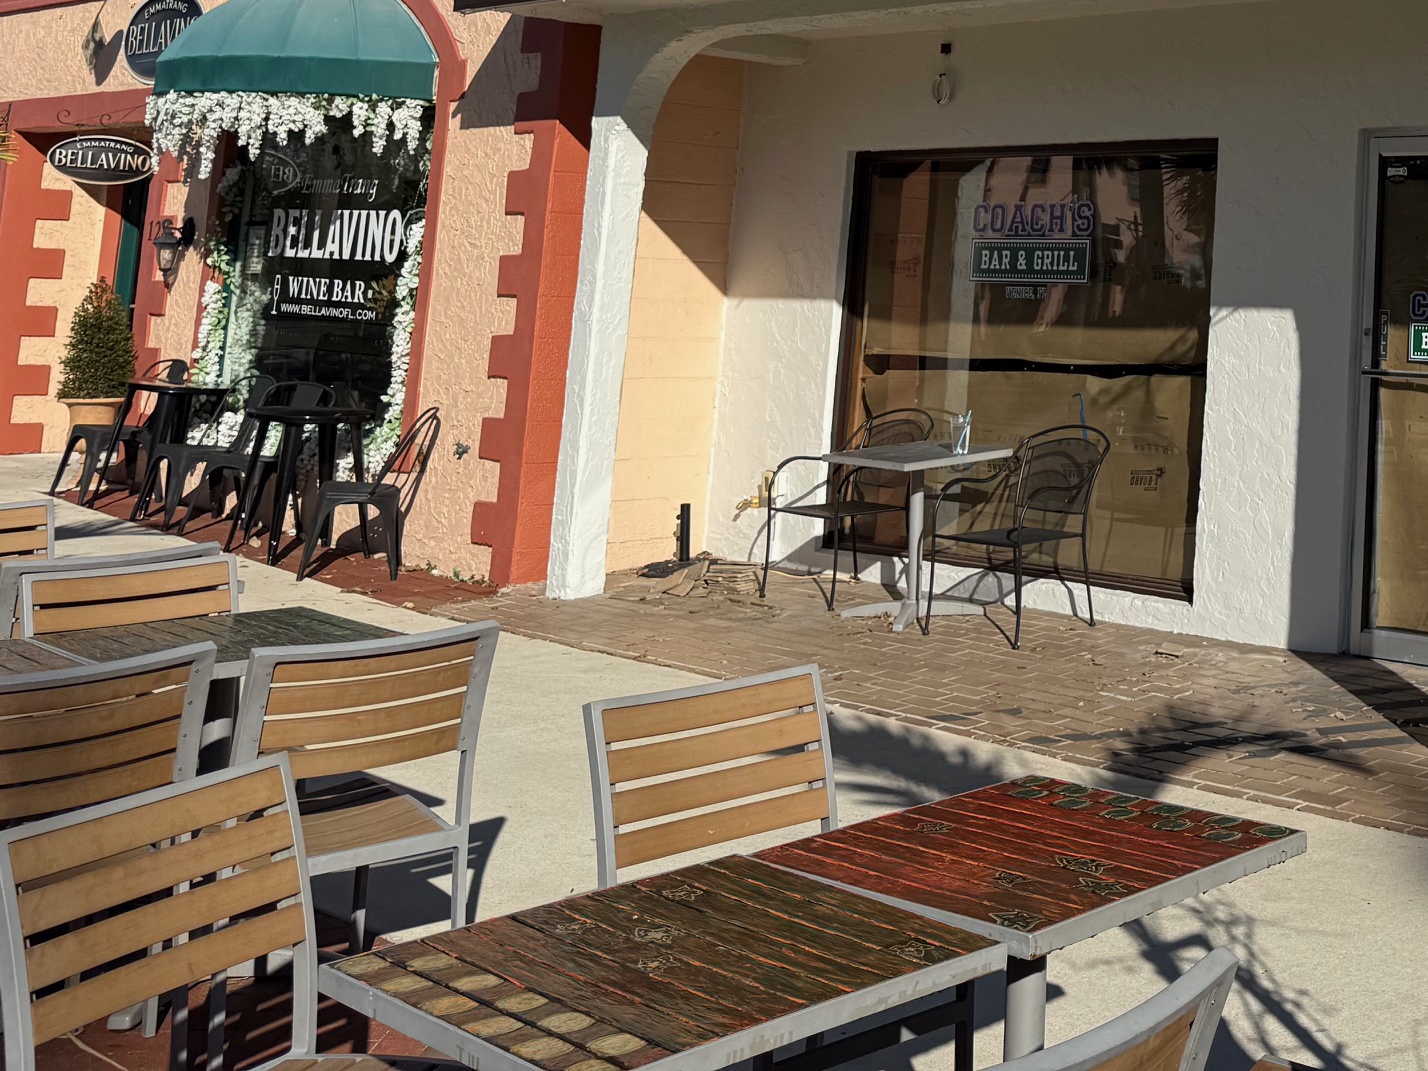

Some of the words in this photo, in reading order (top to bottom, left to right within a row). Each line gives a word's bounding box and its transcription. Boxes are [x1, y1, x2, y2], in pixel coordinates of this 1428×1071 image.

[144, 0, 189, 19] EMMATRANG
[76, 140, 134, 153] EMMATRANG
[54, 148, 150, 172] BELLAVINO
[973, 200, 1095, 236] COACH'S
[268, 208, 402, 263] BELLAVINO
[981, 250, 1010, 269] BAR
[1017, 250, 1026, 269] &
[1034, 250, 1077, 270] GRILL
[288, 275, 329, 301] WINE
[331, 279, 365, 303] BAR
[280, 302, 376, 320] WWW.BELLAVINOFL.COM
